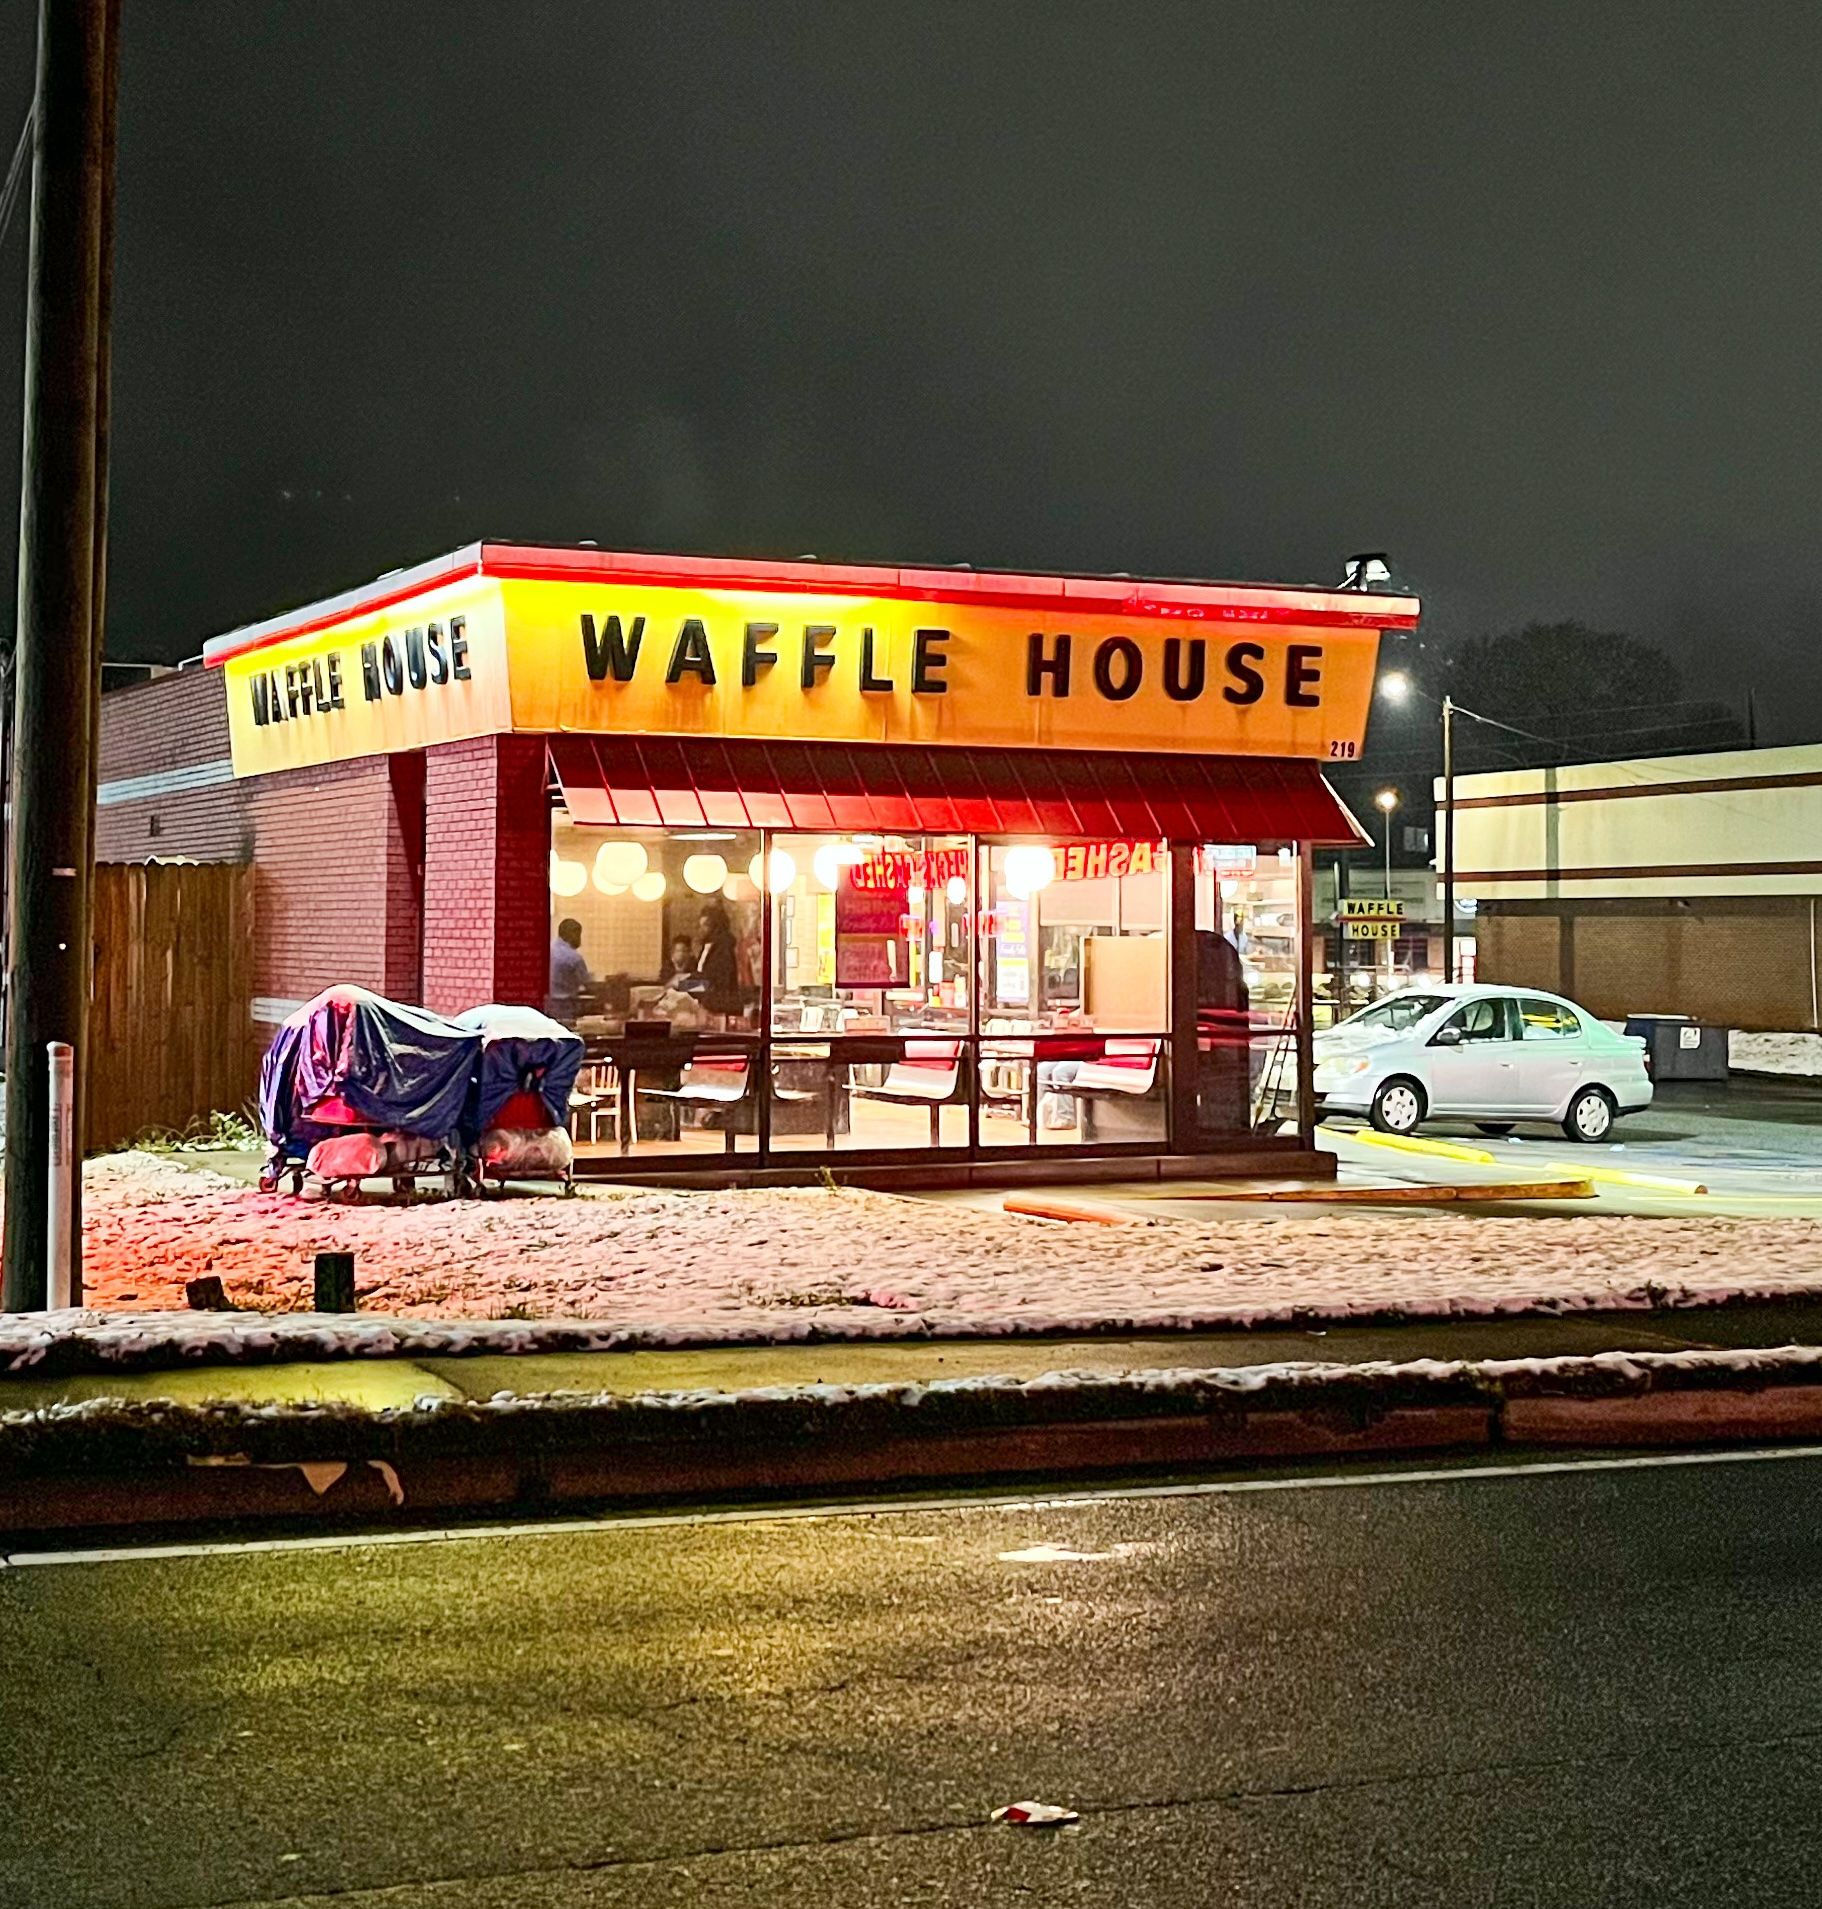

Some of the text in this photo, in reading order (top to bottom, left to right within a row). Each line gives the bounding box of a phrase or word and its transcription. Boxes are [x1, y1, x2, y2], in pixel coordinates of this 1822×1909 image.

[580, 613, 1323, 708] WAFFLE HOUSE
[249, 615, 471, 726] WAFFLE HOUSE
[1330, 740, 1355, 758] 219
[1346, 902, 1404, 915] WAFFLE
[1352, 925, 1397, 937] HOUSE
